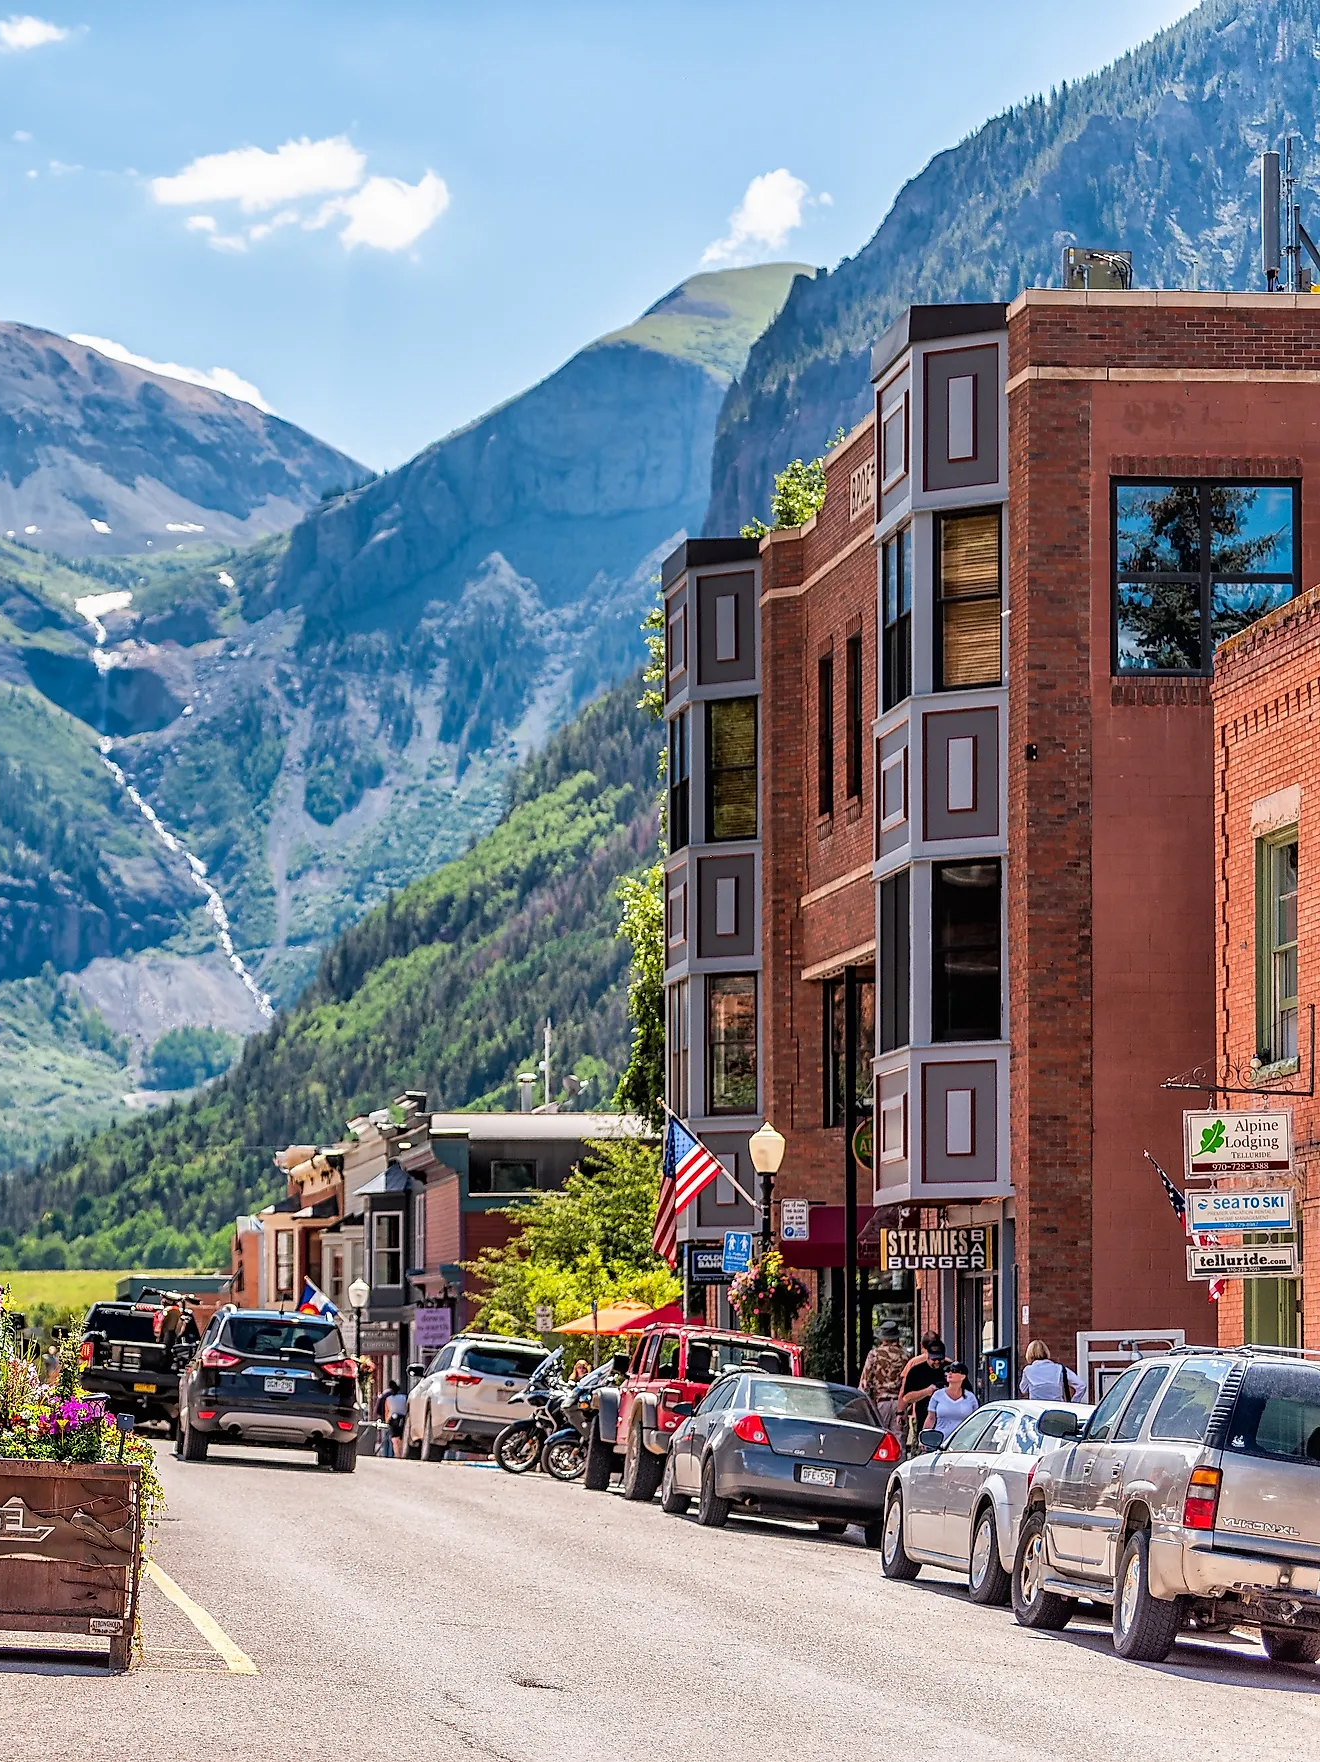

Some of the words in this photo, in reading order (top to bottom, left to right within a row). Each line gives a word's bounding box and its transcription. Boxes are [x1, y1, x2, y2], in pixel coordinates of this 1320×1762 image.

[1234, 1118, 1279, 1135] Alpine
[1225, 1135, 1280, 1151] Lodging
[1231, 1151, 1272, 1159] TELLURIDE
[1212, 1162, 1269, 1171] 970-728-3388
[888, 1229, 968, 1256] STEAMIES
[888, 1256, 985, 1269] BURGER
[1199, 1252, 1287, 1267] telluride.com
[995, 1360, 1006, 1376] P
[1221, 1517, 1277, 1532] YUKON
